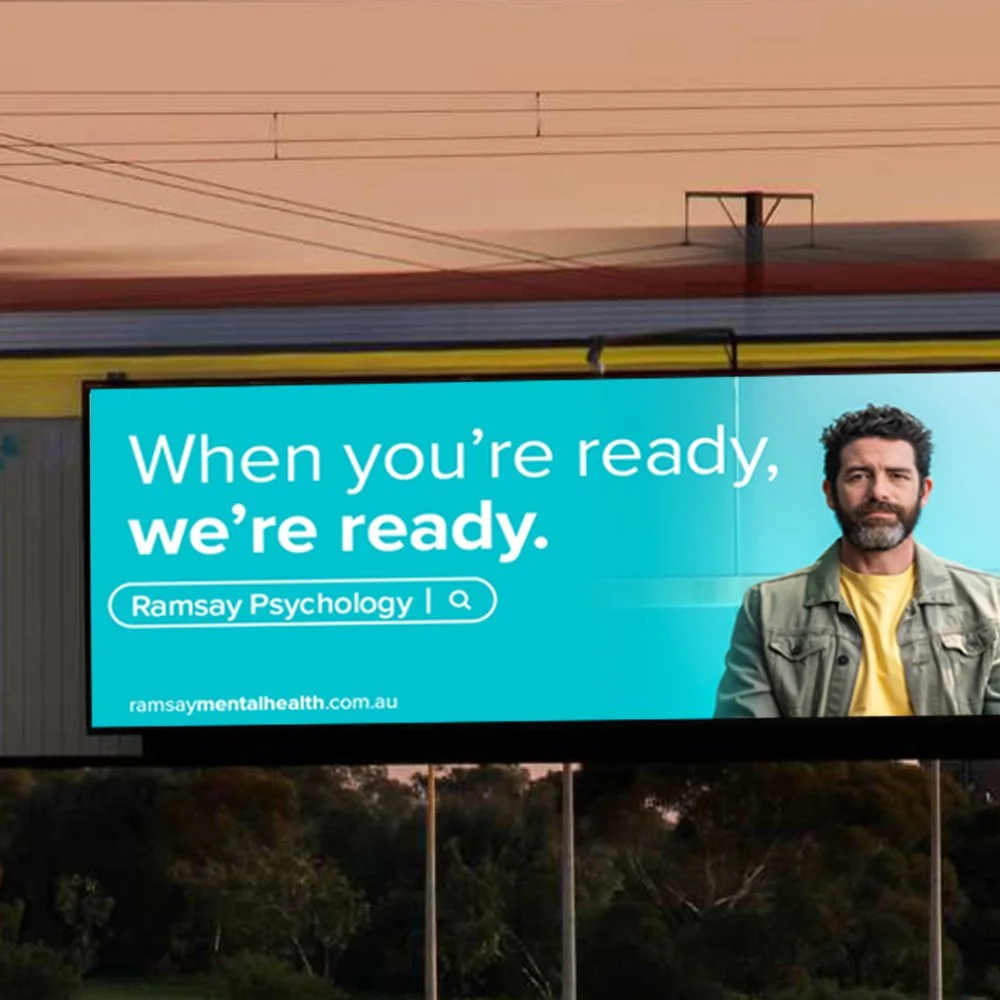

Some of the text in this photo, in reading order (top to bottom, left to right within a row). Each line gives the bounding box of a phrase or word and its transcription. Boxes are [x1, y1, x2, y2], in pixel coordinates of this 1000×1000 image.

[128, 424, 779, 495] When you’re ready,
[128, 499, 549, 564] we’re ready.
[131, 592, 414, 622] Ramsay Psychology
[128, 694, 399, 715] ramsaymentalhealth.com.au
